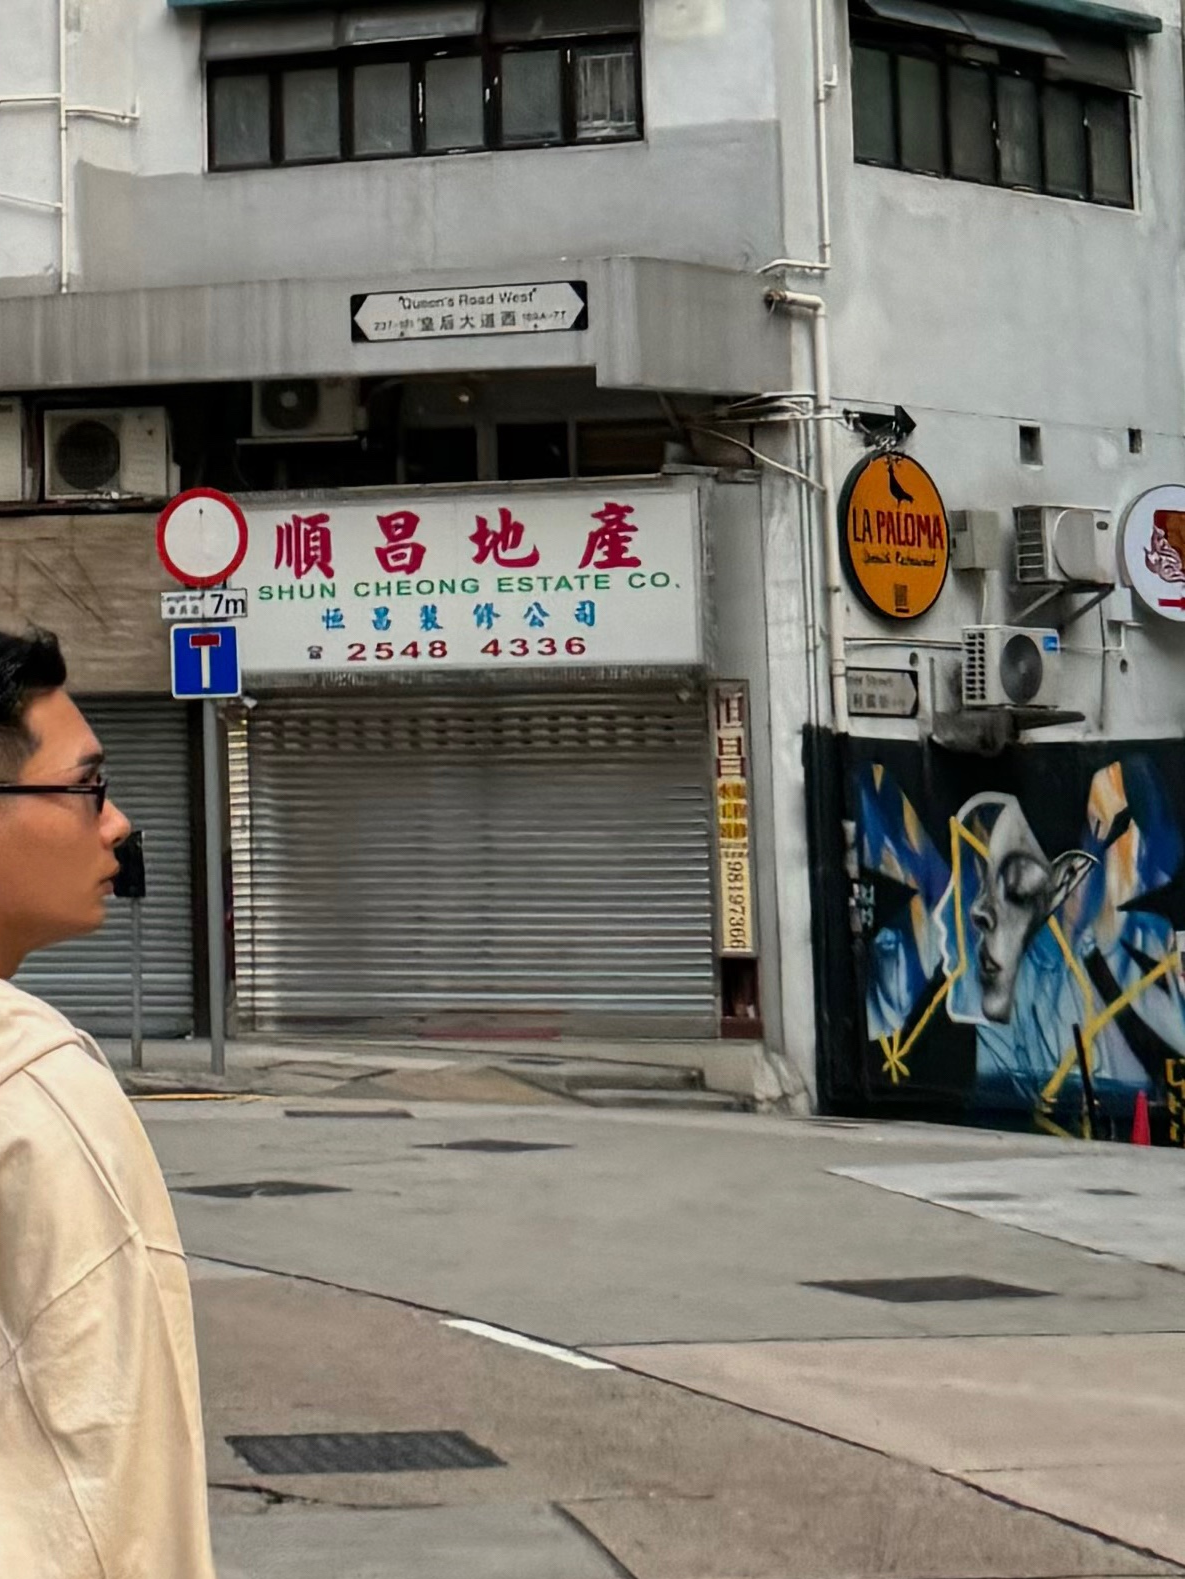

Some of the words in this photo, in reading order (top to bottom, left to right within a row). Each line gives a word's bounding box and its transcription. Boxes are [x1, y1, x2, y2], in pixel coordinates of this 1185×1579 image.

[401, 296, 455, 311] Queen's
[458, 293, 495, 307] Road
[499, 290, 534, 304] West
[420, 310, 516, 333] 皇后大道西
[274, 501, 643, 580] 順昌地產
[852, 506, 873, 544] LA
[876, 509, 945, 551] PALOMA
[258, 583, 337, 601] SHUN
[353, 577, 481, 597] CHEONG
[496, 574, 611, 594] ESTATE
[627, 571, 681, 590] CO.
[210, 594, 245, 615] 7m
[347, 640, 449, 662] 2548
[480, 636, 588, 658] 4336
